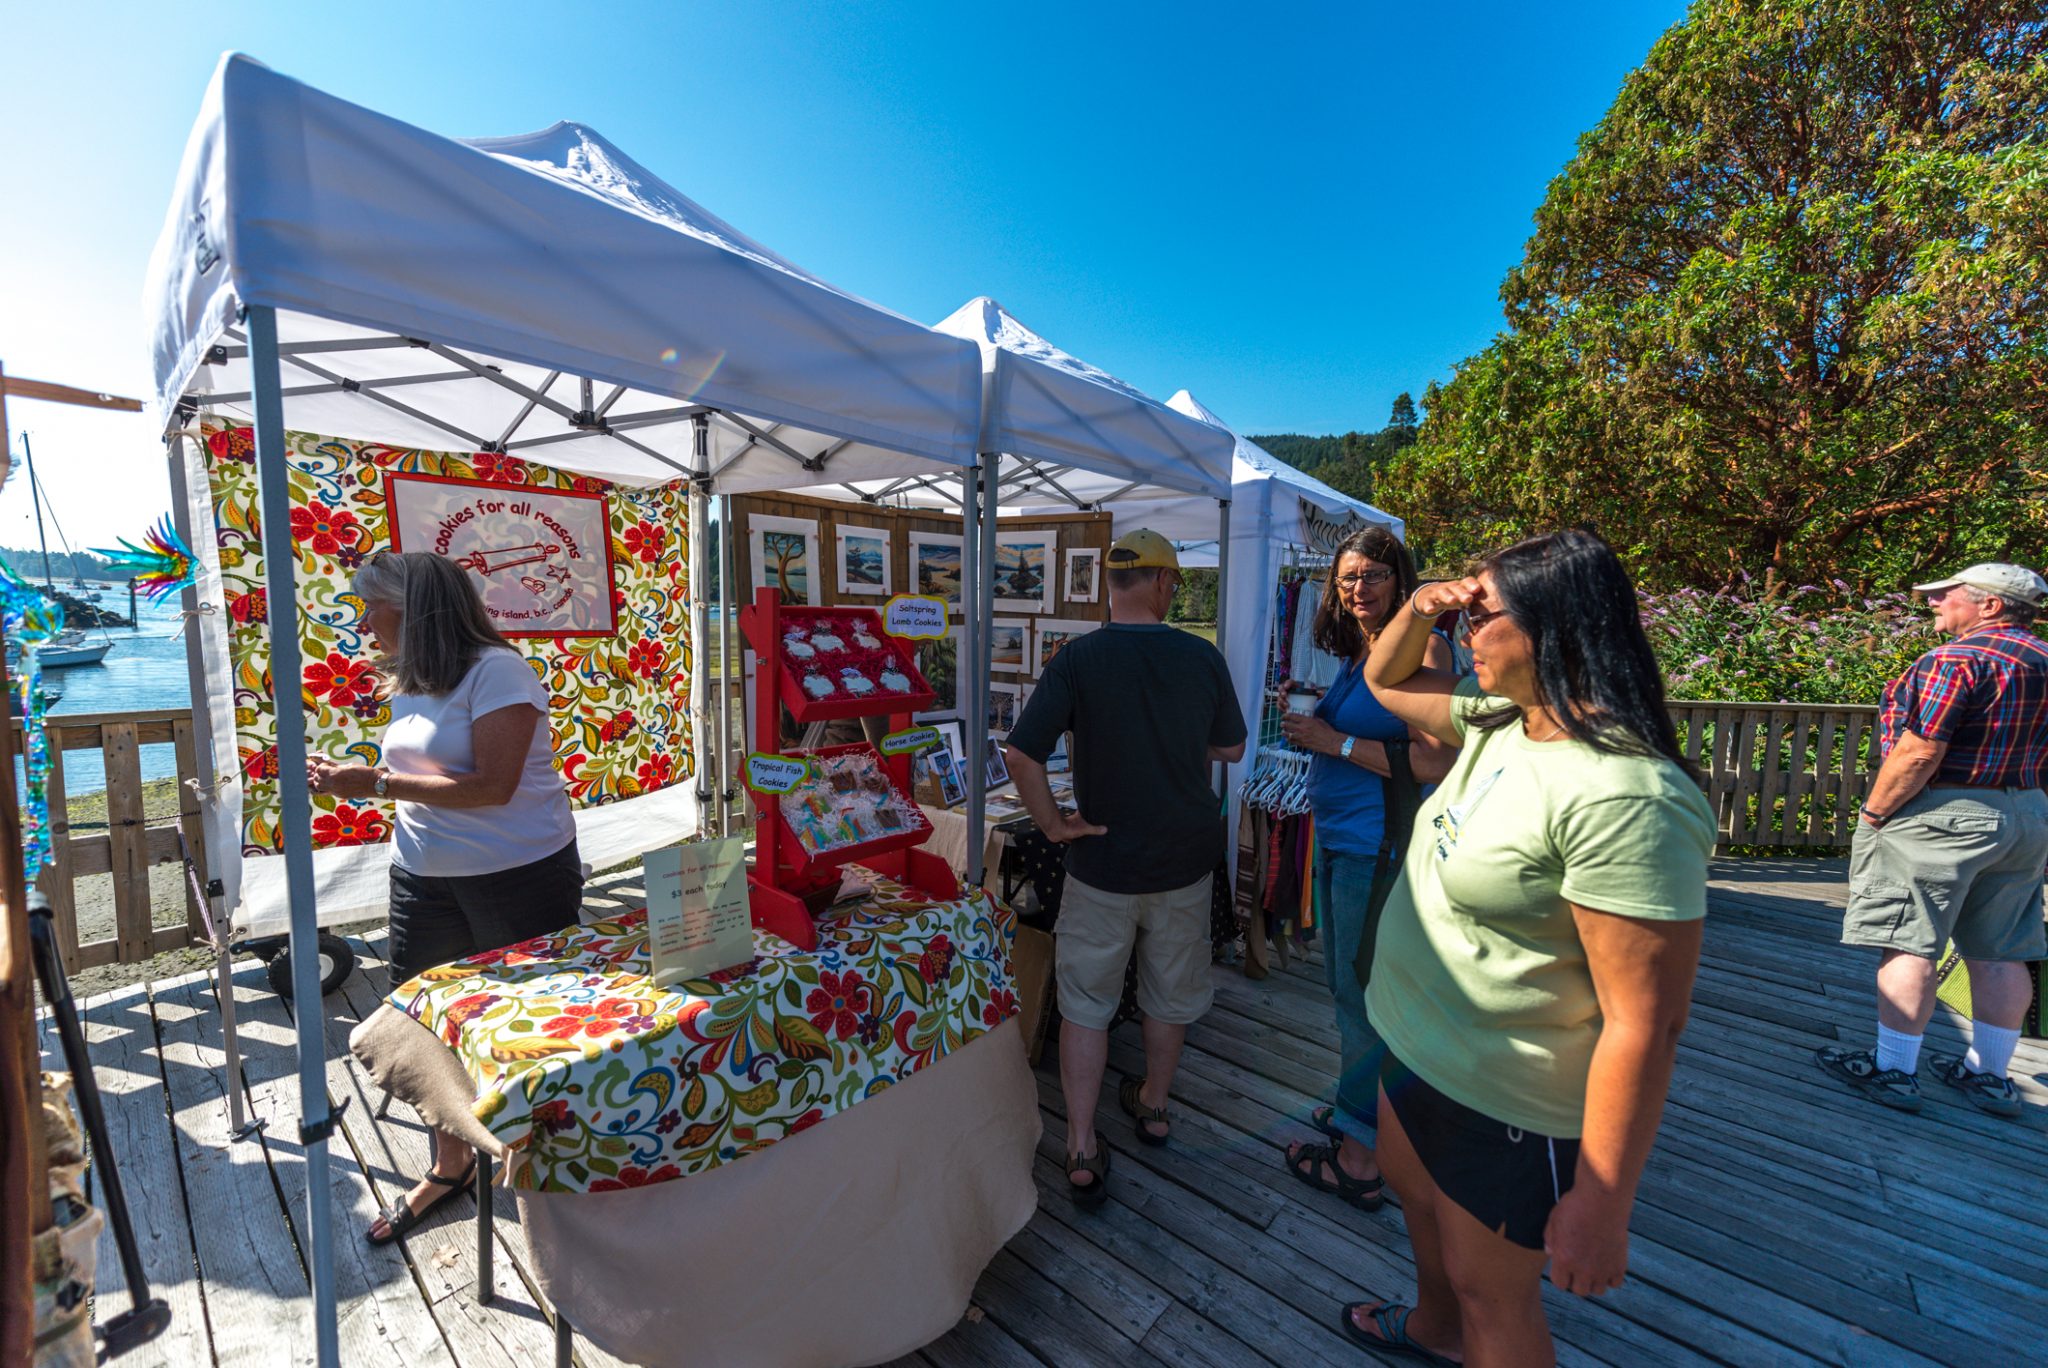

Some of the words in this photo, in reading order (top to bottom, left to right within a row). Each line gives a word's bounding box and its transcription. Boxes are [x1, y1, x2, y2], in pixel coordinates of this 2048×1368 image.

[434, 506, 475, 556] cookies
[476, 499, 505, 515] for
[510, 501, 531, 517] all
[533, 510, 581, 560] reasons
[553, 587, 574, 610] canada
[898, 604, 937, 616] Saltspring
[892, 617, 912, 625] Lamb
[914, 618, 942, 627] Cookies
[884, 737, 907, 748] Horse
[909, 731, 936, 743] Cookies
[752, 760, 784, 773] Tropical
[785, 765, 803, 775] Fish
[757, 777, 788, 788] Cookies
[671, 888, 682, 899] $3
[685, 885, 703, 895] each
[706, 880, 728, 891] today
